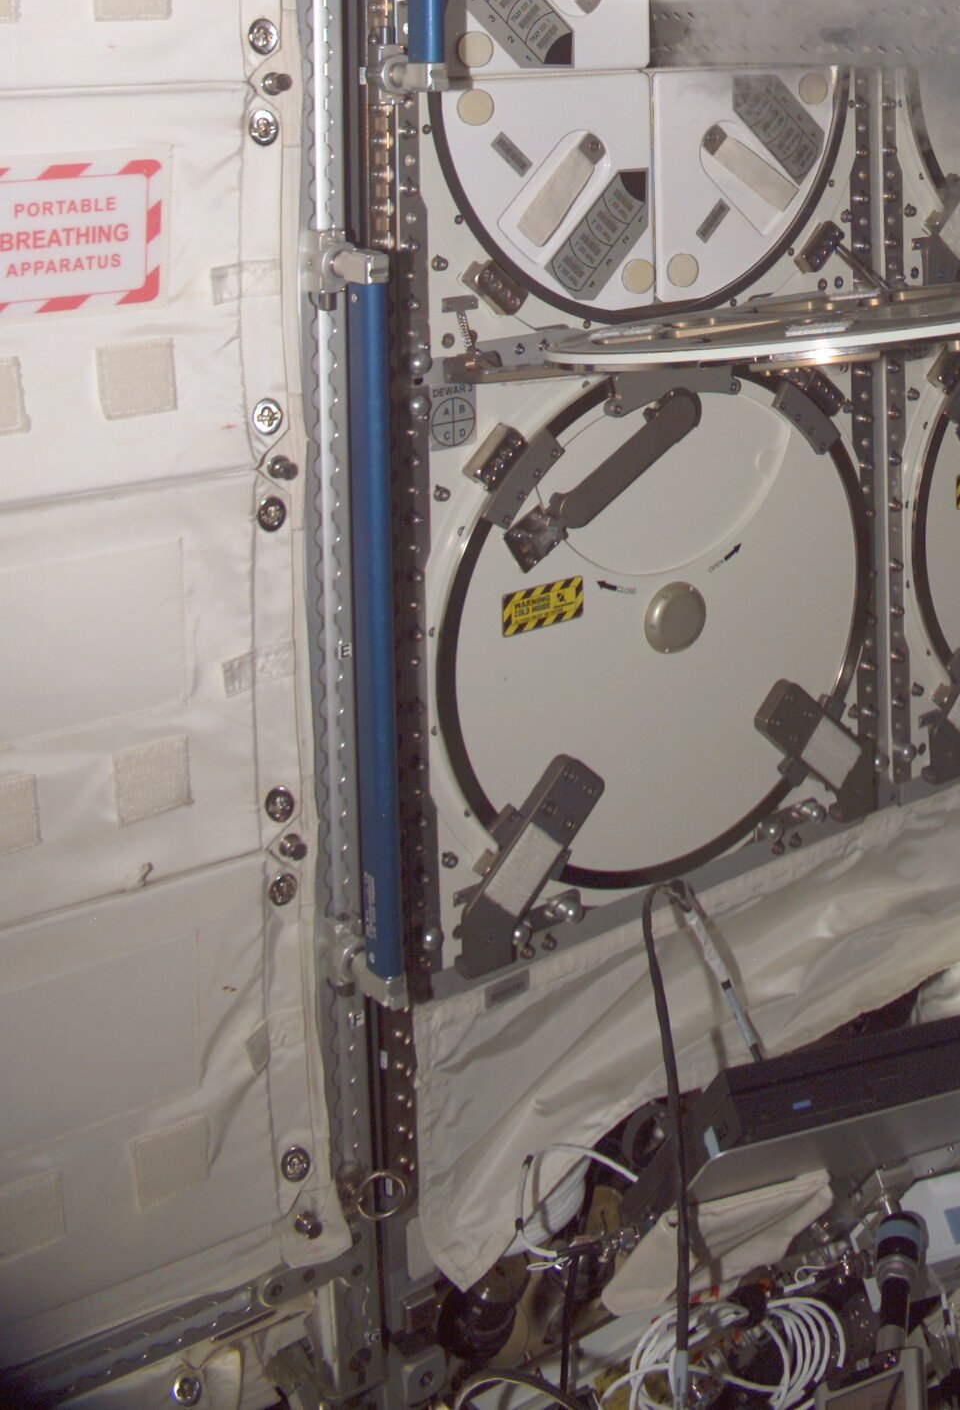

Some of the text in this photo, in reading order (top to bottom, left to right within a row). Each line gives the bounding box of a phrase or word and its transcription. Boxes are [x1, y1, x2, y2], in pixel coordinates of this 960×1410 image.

[14, 196, 117, 218] PORTABLE
[0, 223, 129, 252] BREATHING
[5, 253, 121, 278] APPARATUS
[433, 384, 466, 398] DEWAR
[443, 404, 466, 416] A B
[444, 428, 466, 440] C D
[515, 594, 551, 609] WARNING
[341, 644, 350, 658] E
[353, 1013, 362, 1026] F
